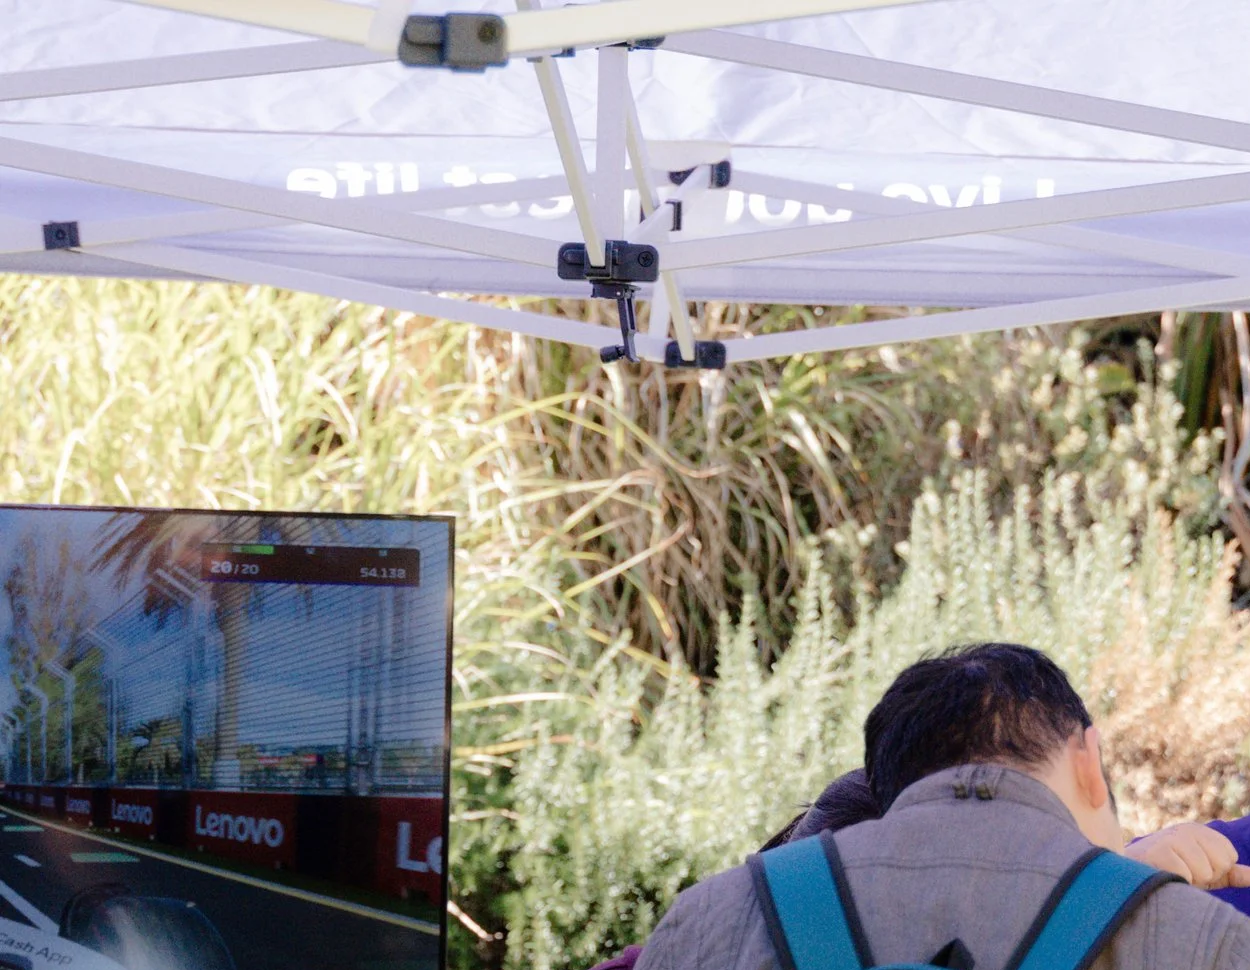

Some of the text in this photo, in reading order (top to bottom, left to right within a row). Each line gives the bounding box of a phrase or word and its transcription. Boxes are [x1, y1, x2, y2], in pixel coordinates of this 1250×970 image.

[111, 798, 153, 825] Lenovo
[195, 804, 285, 848] Lenovo
[35, 947, 73, 965] App
